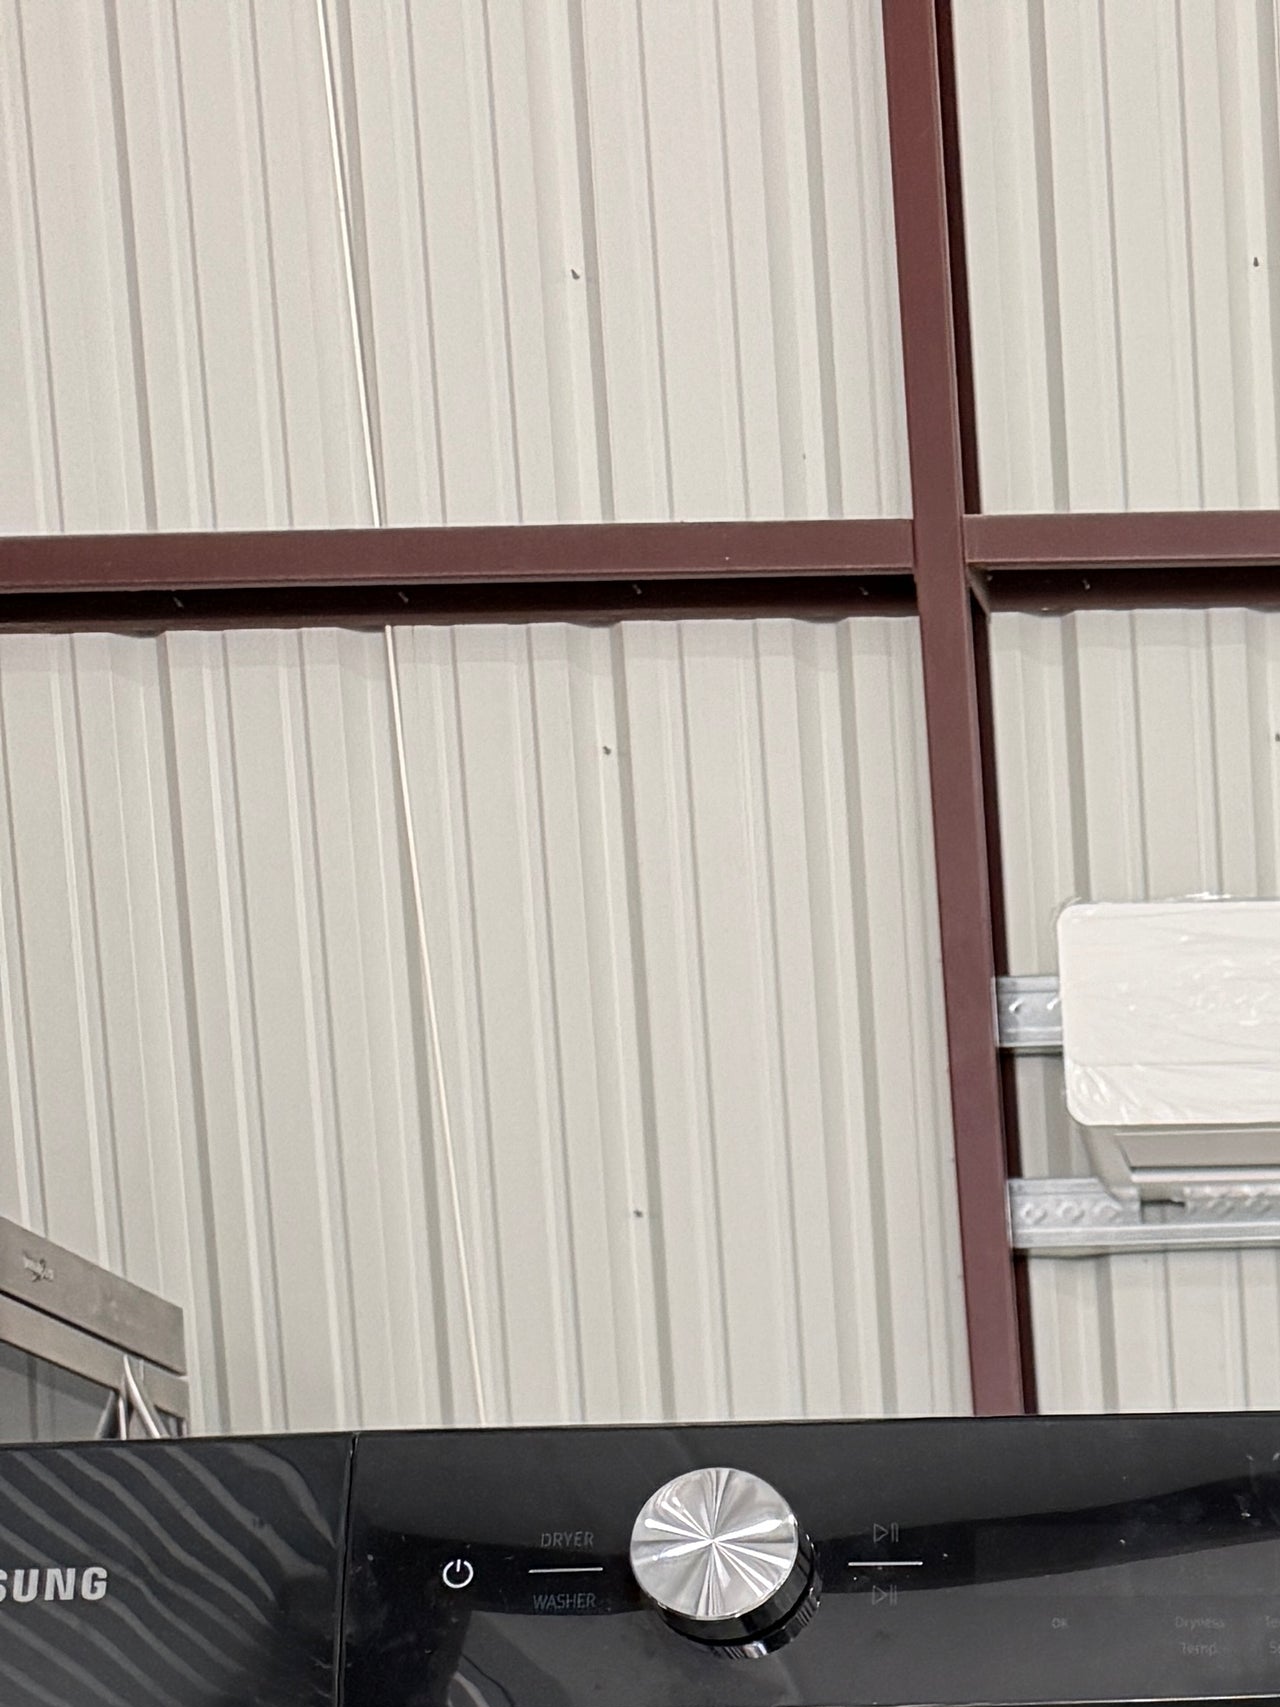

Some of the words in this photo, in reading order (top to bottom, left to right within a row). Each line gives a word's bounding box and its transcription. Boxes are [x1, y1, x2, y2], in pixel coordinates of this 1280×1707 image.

[540, 1531, 594, 1548] DRYER
[0, 1566, 108, 1603] UNG
[532, 1592, 597, 1610] WASHER
